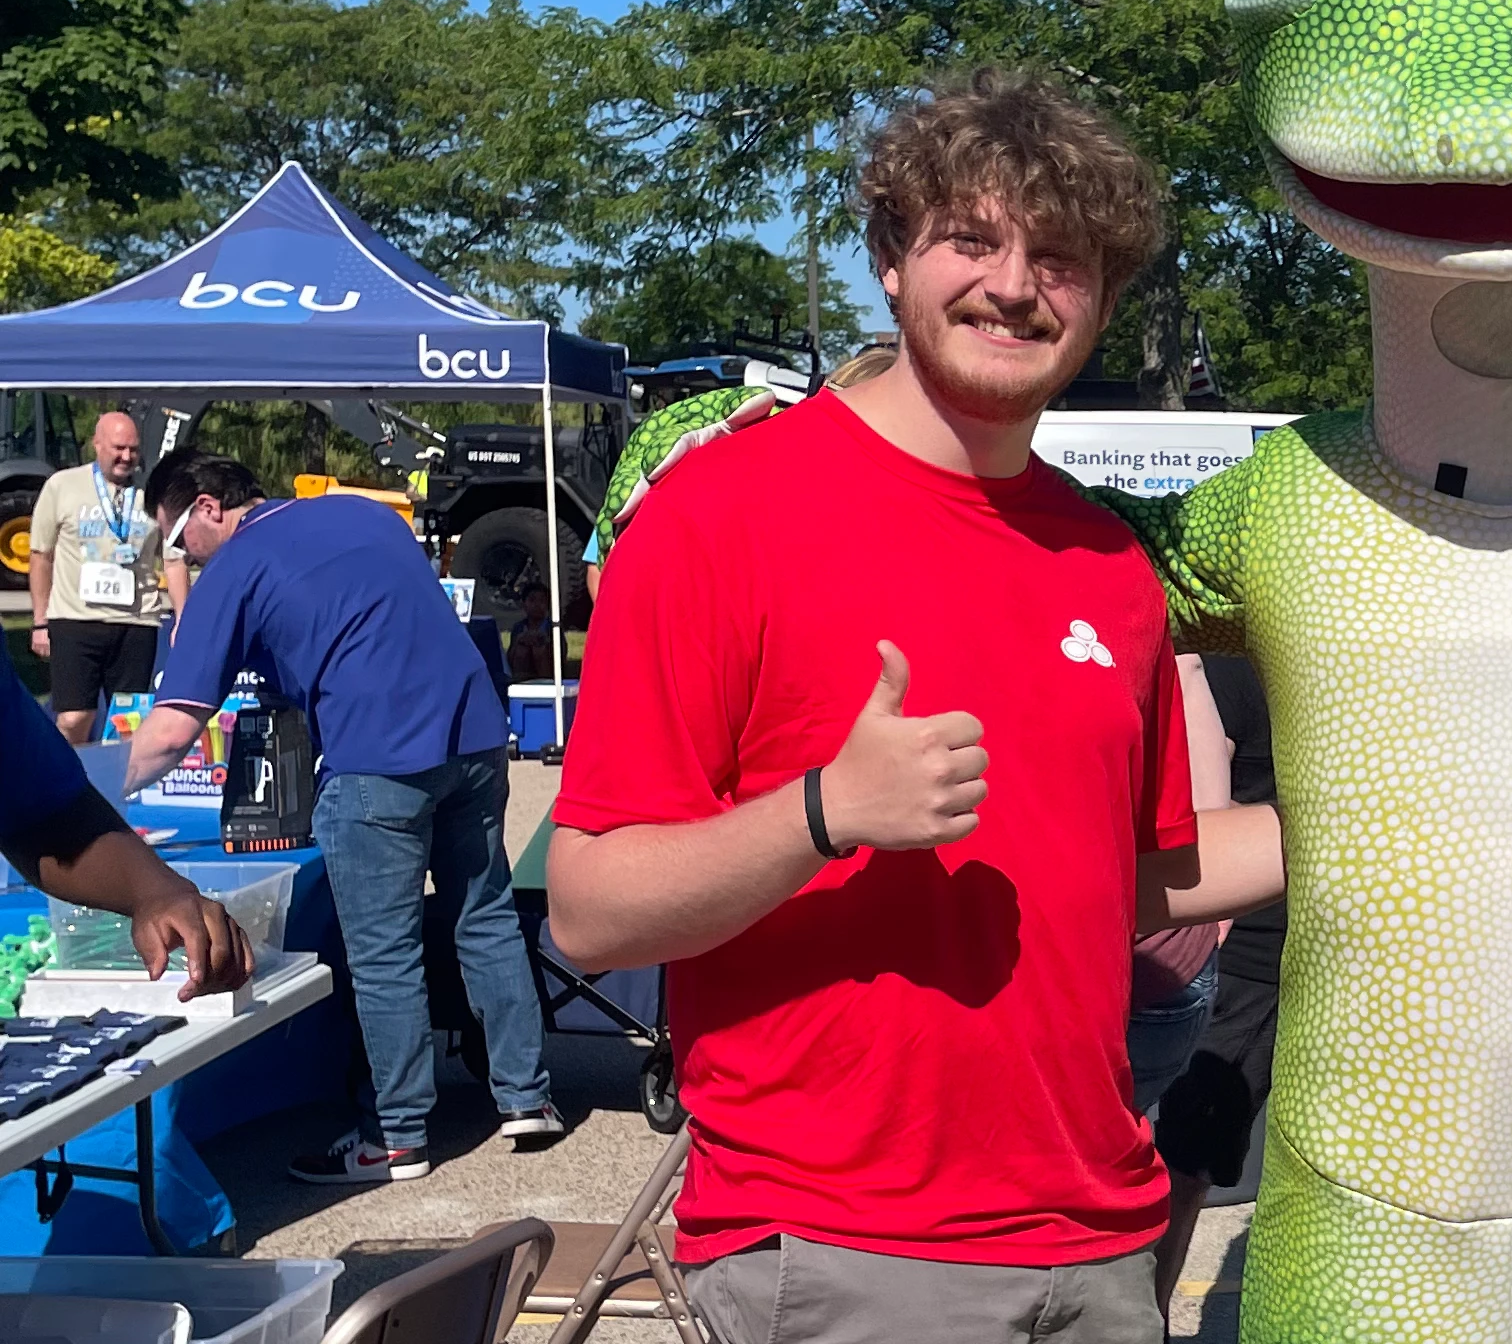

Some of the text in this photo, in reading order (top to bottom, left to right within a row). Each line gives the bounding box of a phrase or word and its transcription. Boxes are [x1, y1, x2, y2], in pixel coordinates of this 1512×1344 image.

[179, 271, 361, 313] bcu
[418, 333, 511, 380] bcu
[1063, 450, 1145, 471] Banking
[1150, 451, 1191, 467] that
[1105, 474, 1195, 490] the extra
[165, 782, 223, 795] Balloons
